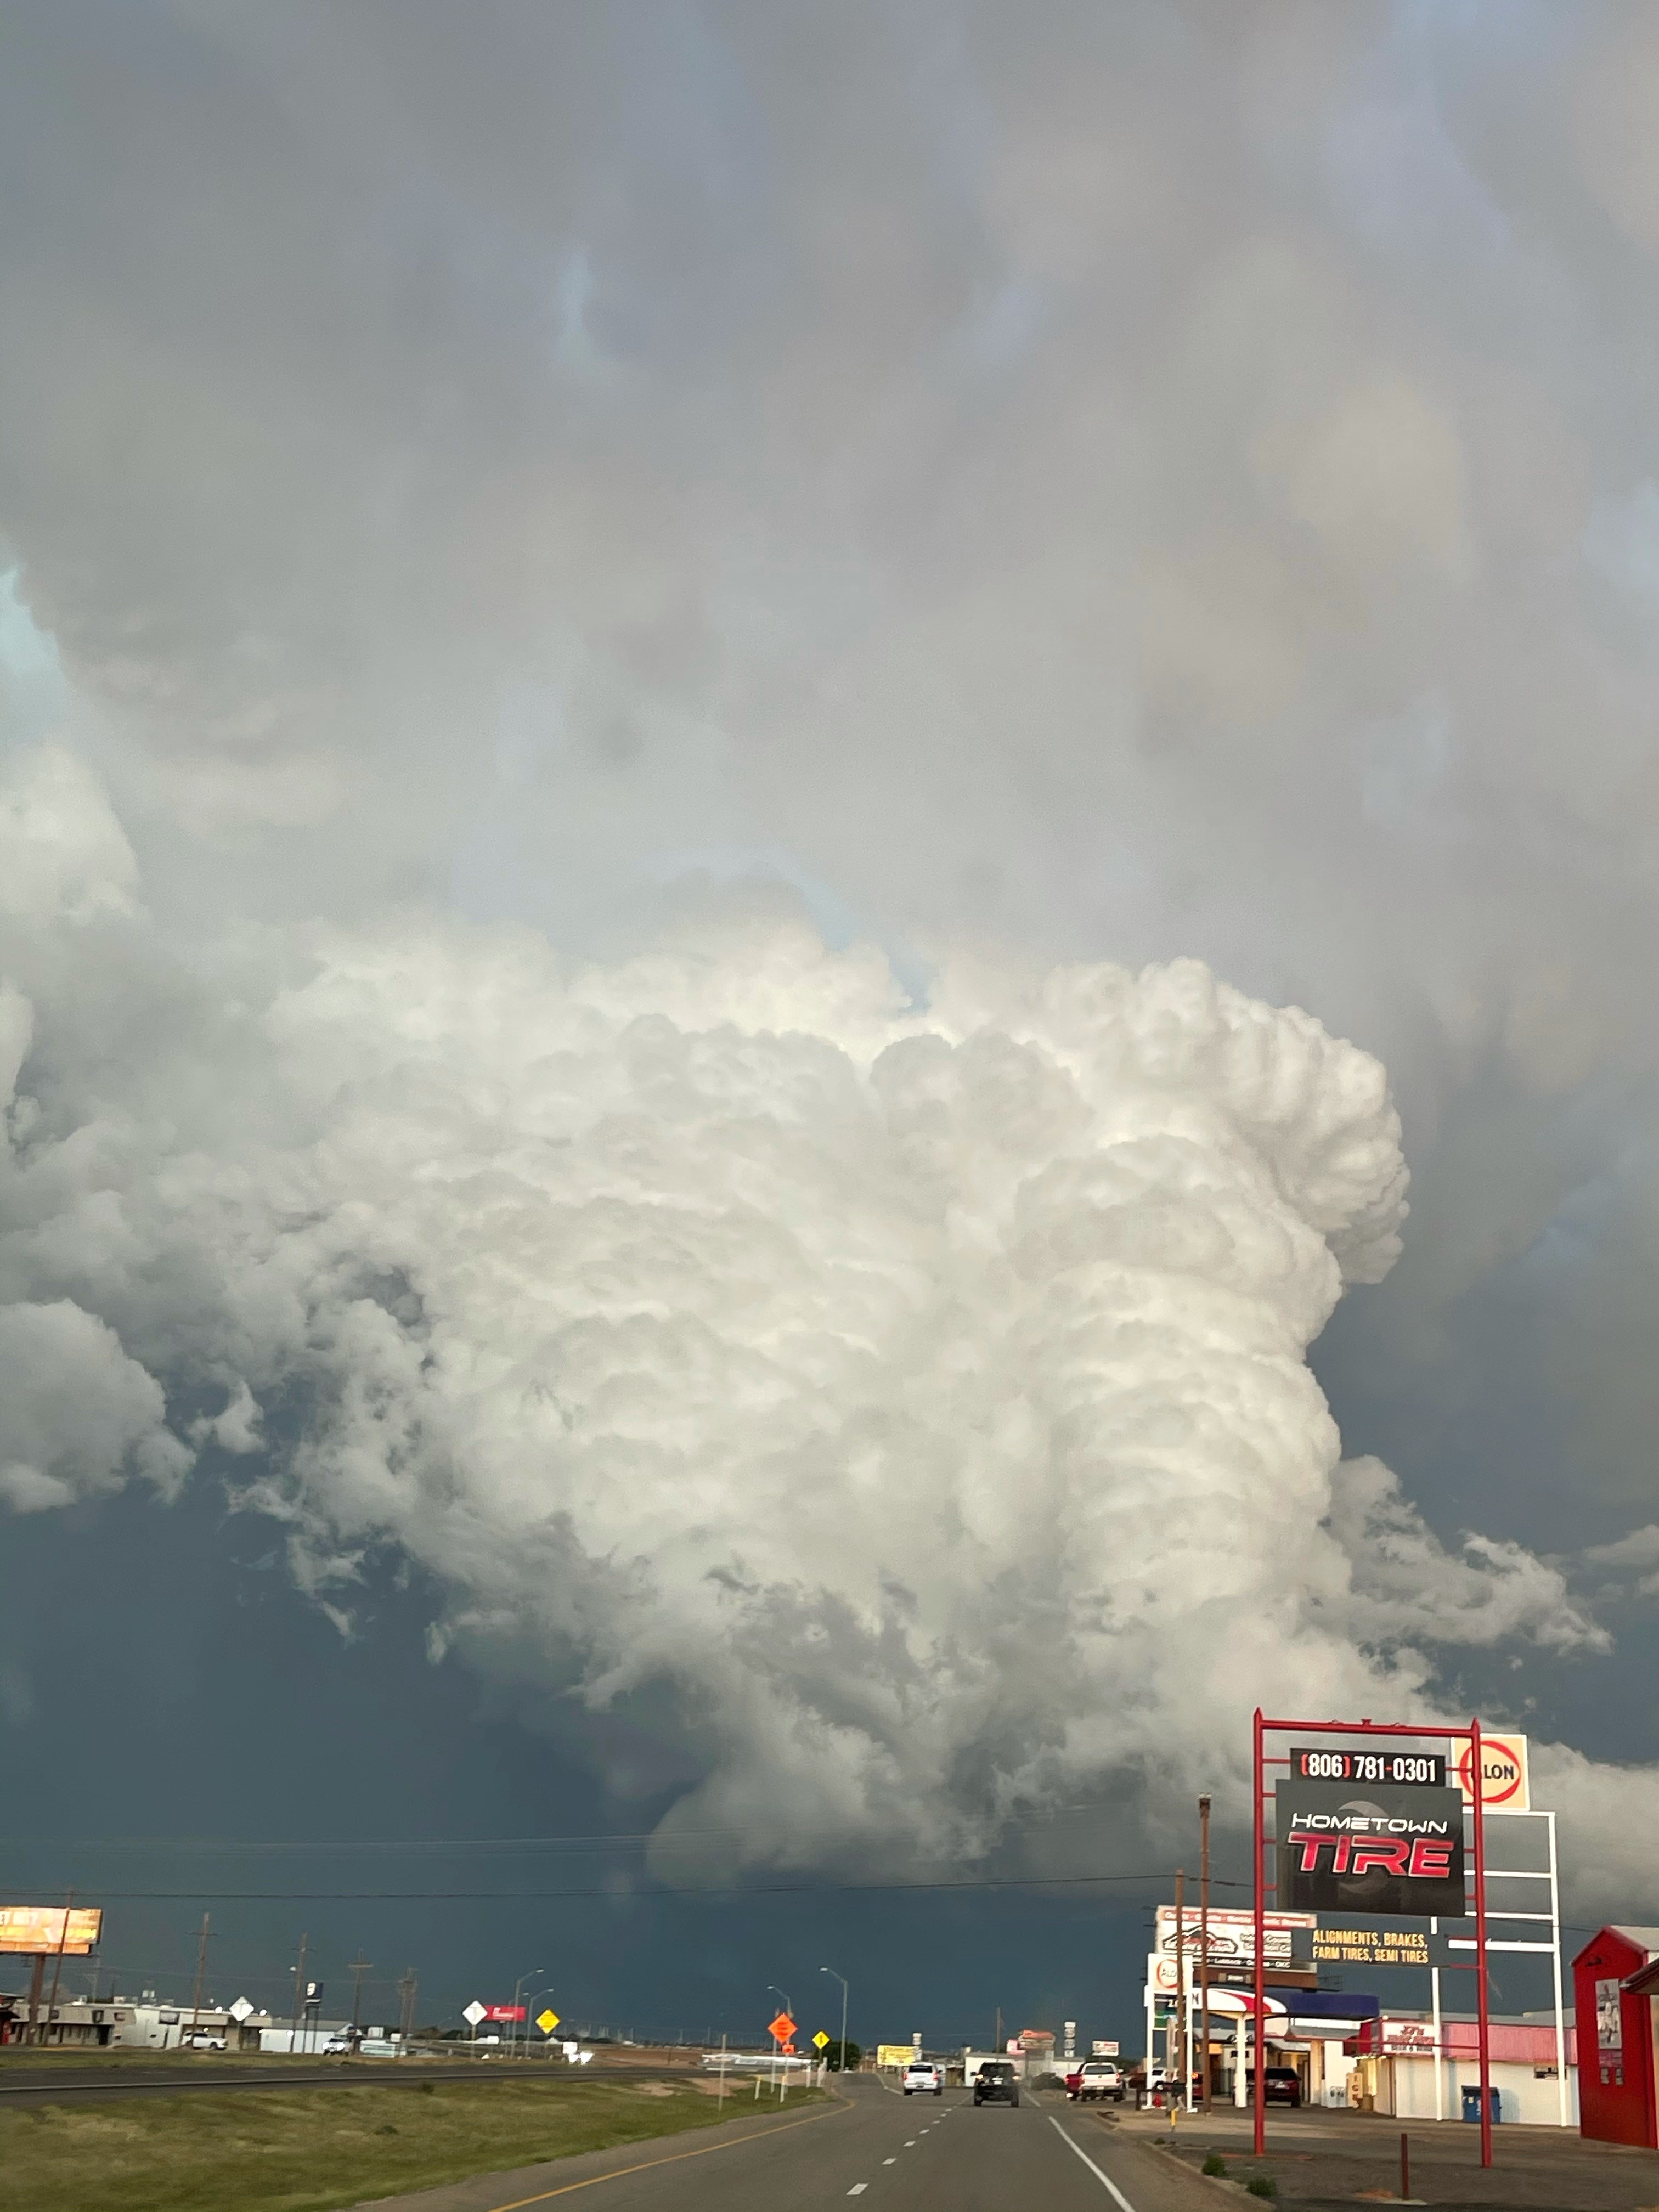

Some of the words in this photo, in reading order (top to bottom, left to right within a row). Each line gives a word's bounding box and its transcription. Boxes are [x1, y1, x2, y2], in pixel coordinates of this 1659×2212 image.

[1301, 1753, 1350, 1778] (806)
[1353, 1756, 1436, 1782] 781-0301
[1291, 1813, 1447, 1834] HOMETOWN
[1288, 1832, 1454, 1878] TIRE
[1312, 1929, 1382, 1947] ALIGNMENTS,
[1384, 1932, 1429, 1949] BRAKES,
[1312, 1946, 1340, 1959] FARM
[1342, 1948, 1372, 1962] TIRES,
[1374, 1949, 1398, 1962] SEMI
[1400, 1950, 1429, 1963] TIRES
